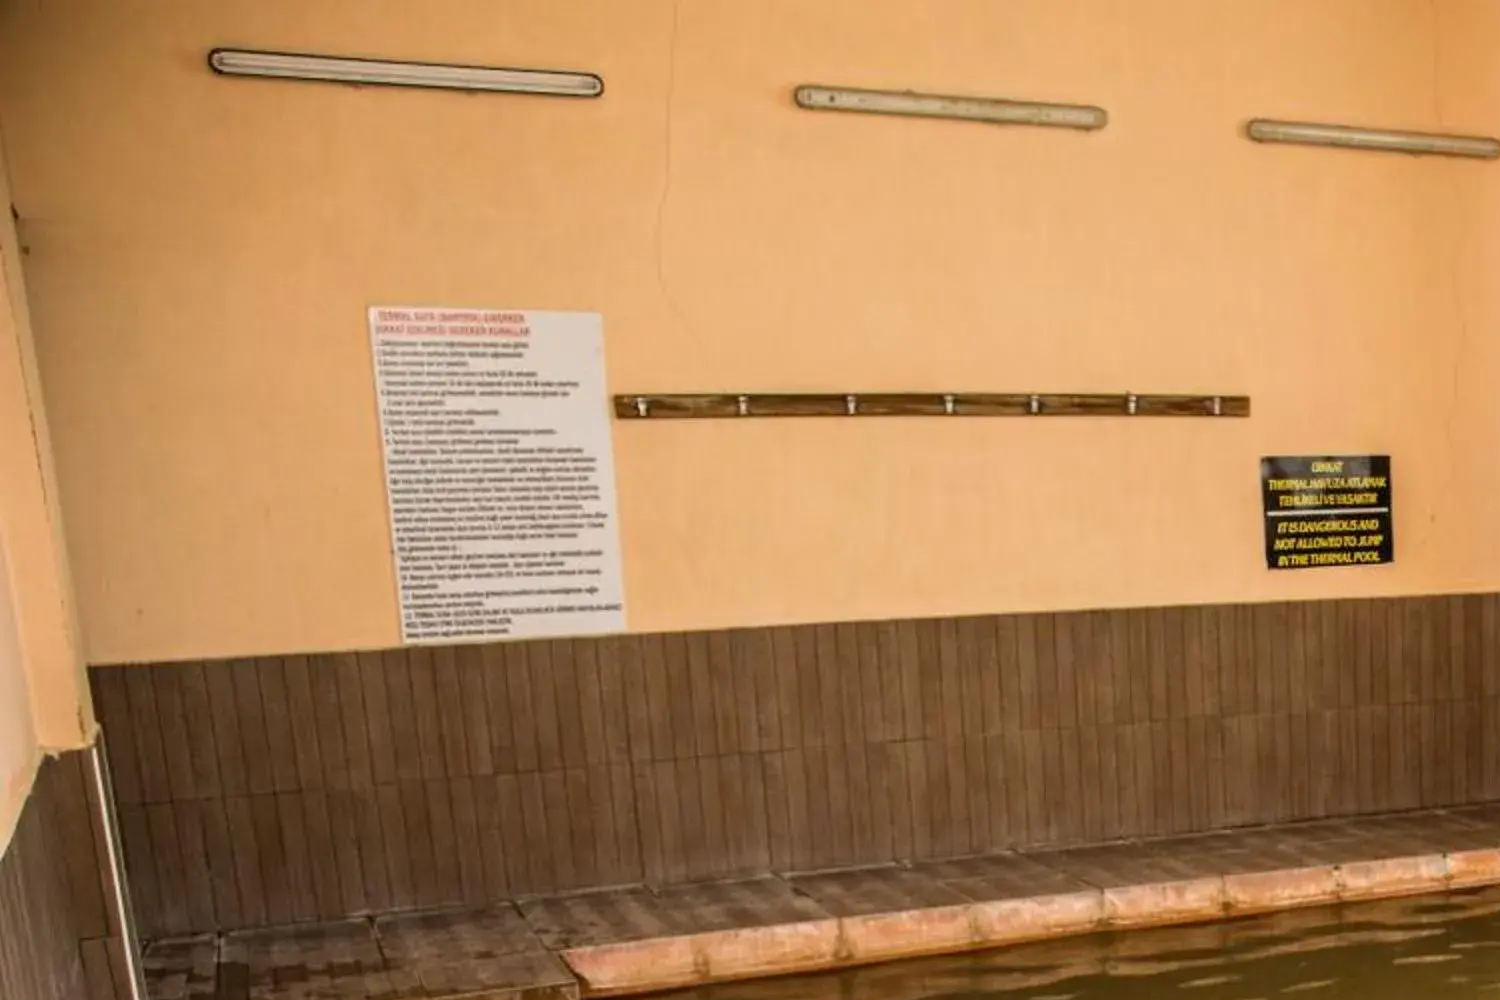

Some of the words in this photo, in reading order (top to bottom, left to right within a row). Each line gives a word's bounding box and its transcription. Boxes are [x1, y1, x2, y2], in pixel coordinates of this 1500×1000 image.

[1278, 522, 1288, 534] IT
[1288, 521, 1299, 532] IS
[1300, 520, 1357, 532] DANGEROUS
[1358, 519, 1379, 530] AND
[1274, 538, 1295, 550] NOT
[1296, 536, 1342, 549] ALLOWED
[1344, 536, 1357, 547] TO
[1358, 534, 1384, 547] JUMP
[1278, 555, 1289, 566] IN
[1289, 554, 1308, 565] THE
[1310, 552, 1352, 564] THERMAL
[1353, 551, 1380, 563] POOL
